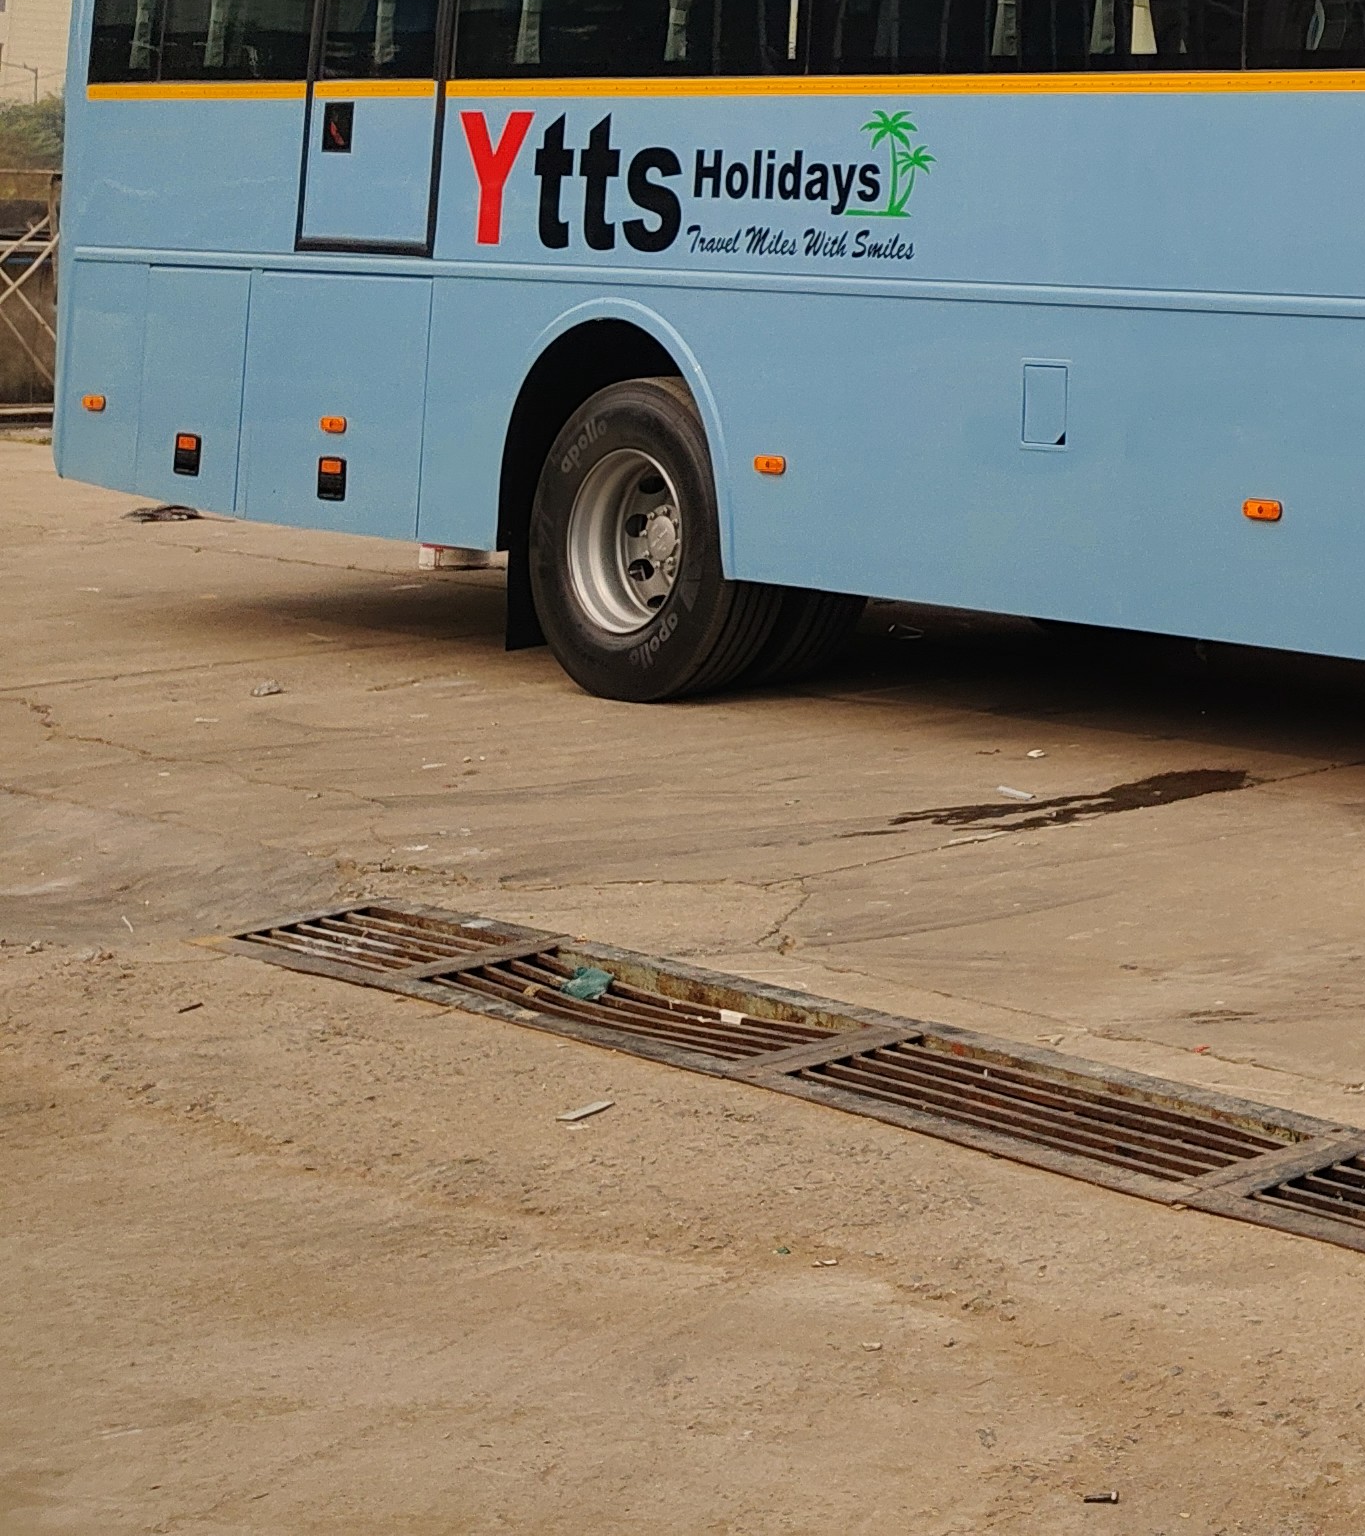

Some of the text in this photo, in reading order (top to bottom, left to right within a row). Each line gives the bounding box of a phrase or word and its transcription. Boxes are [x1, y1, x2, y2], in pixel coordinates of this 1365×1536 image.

[459, 110, 881, 252] Ytts Holidays
[686, 224, 916, 261] Travel Miles With Smiles
[561, 418, 608, 474] apollo
